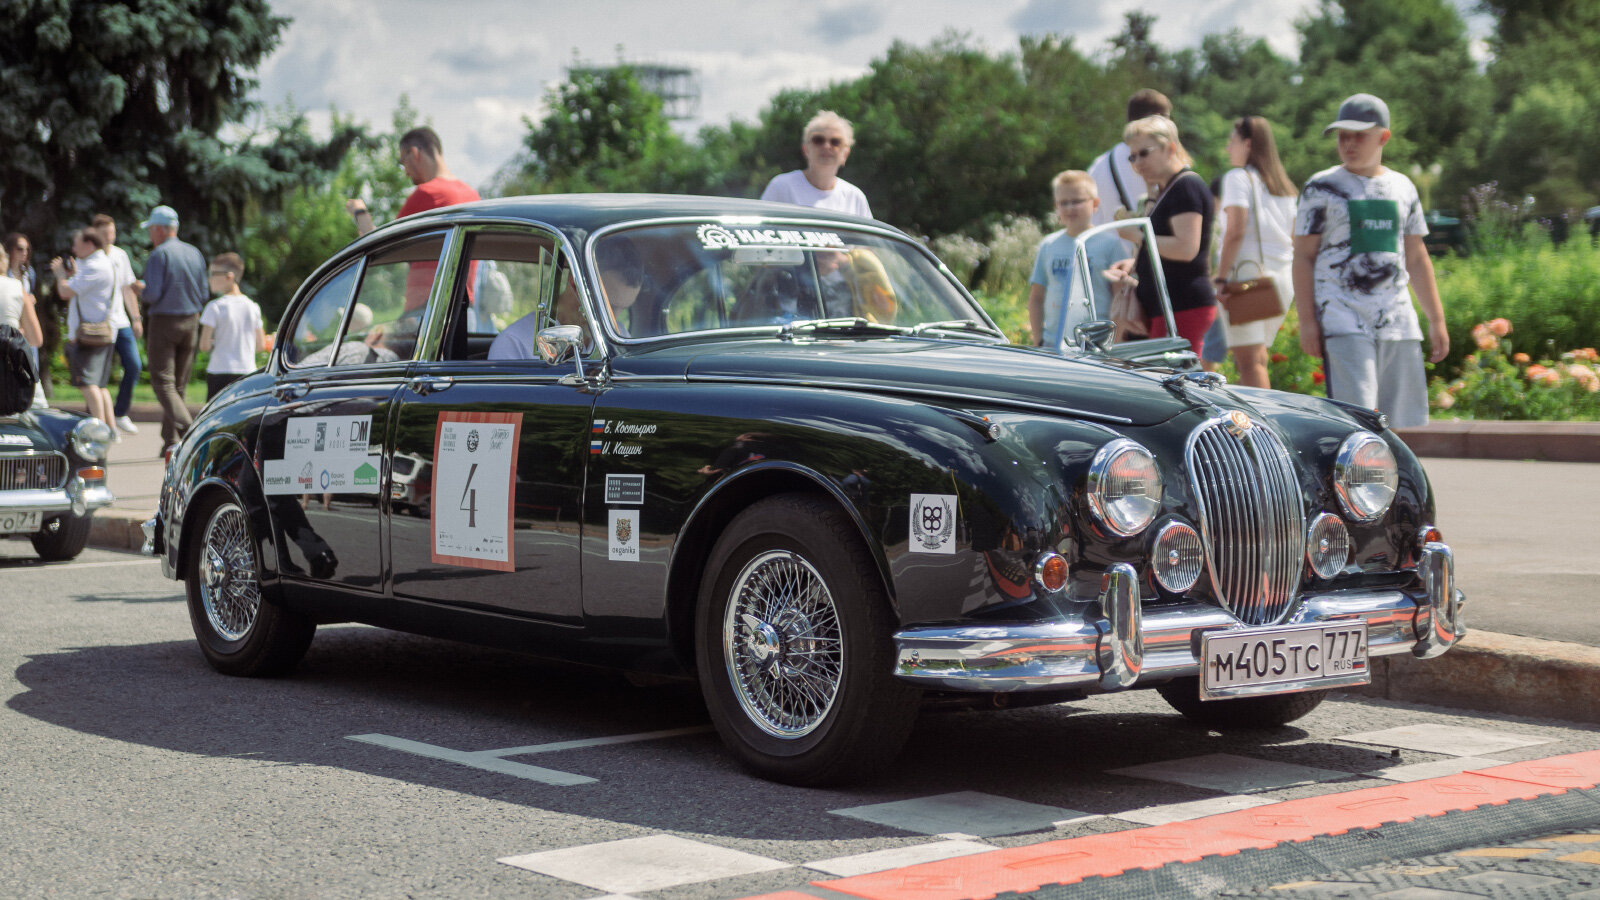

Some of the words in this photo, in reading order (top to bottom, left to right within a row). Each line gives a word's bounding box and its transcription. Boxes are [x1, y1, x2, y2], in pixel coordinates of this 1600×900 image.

[734, 229, 845, 247] НАСЛЕДИЕ
[604, 420, 612, 434] Б.
[614, 420, 657, 438] Костырко
[601, 441, 611, 455] И.
[612, 441, 643, 457] Кашин
[459, 463, 478, 528] 4
[1216, 639, 1320, 682] М405ТС
[1325, 630, 1362, 660] 777
[1333, 659, 1352, 671] RUS
